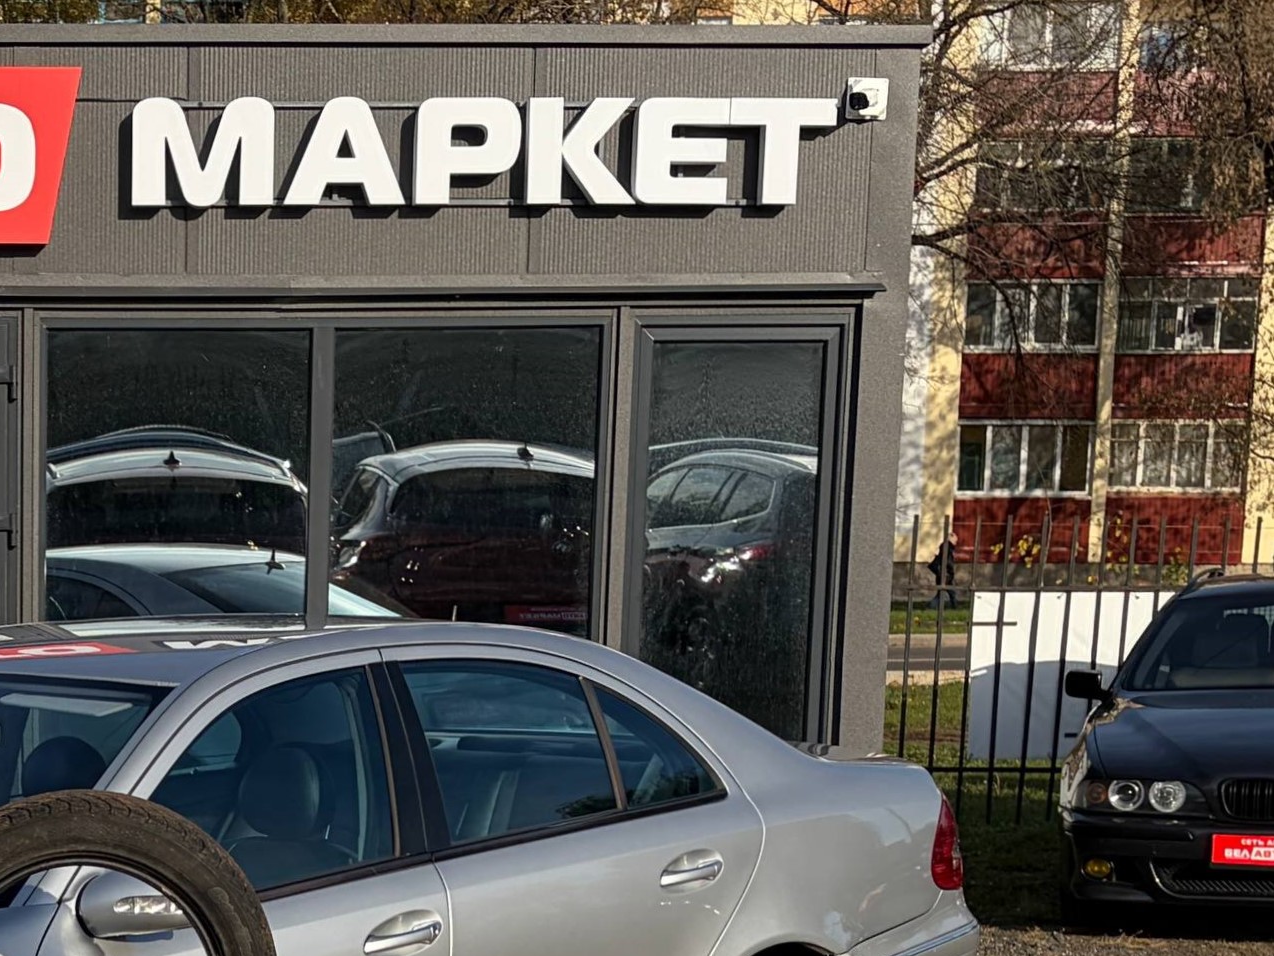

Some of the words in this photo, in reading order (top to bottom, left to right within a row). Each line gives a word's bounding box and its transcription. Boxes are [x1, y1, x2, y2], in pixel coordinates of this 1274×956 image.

[131, 96, 839, 207] МАРКЕТ
[1241, 839, 1265, 847] СЕТЬ
[1225, 848, 1251, 860] БЕЛ
